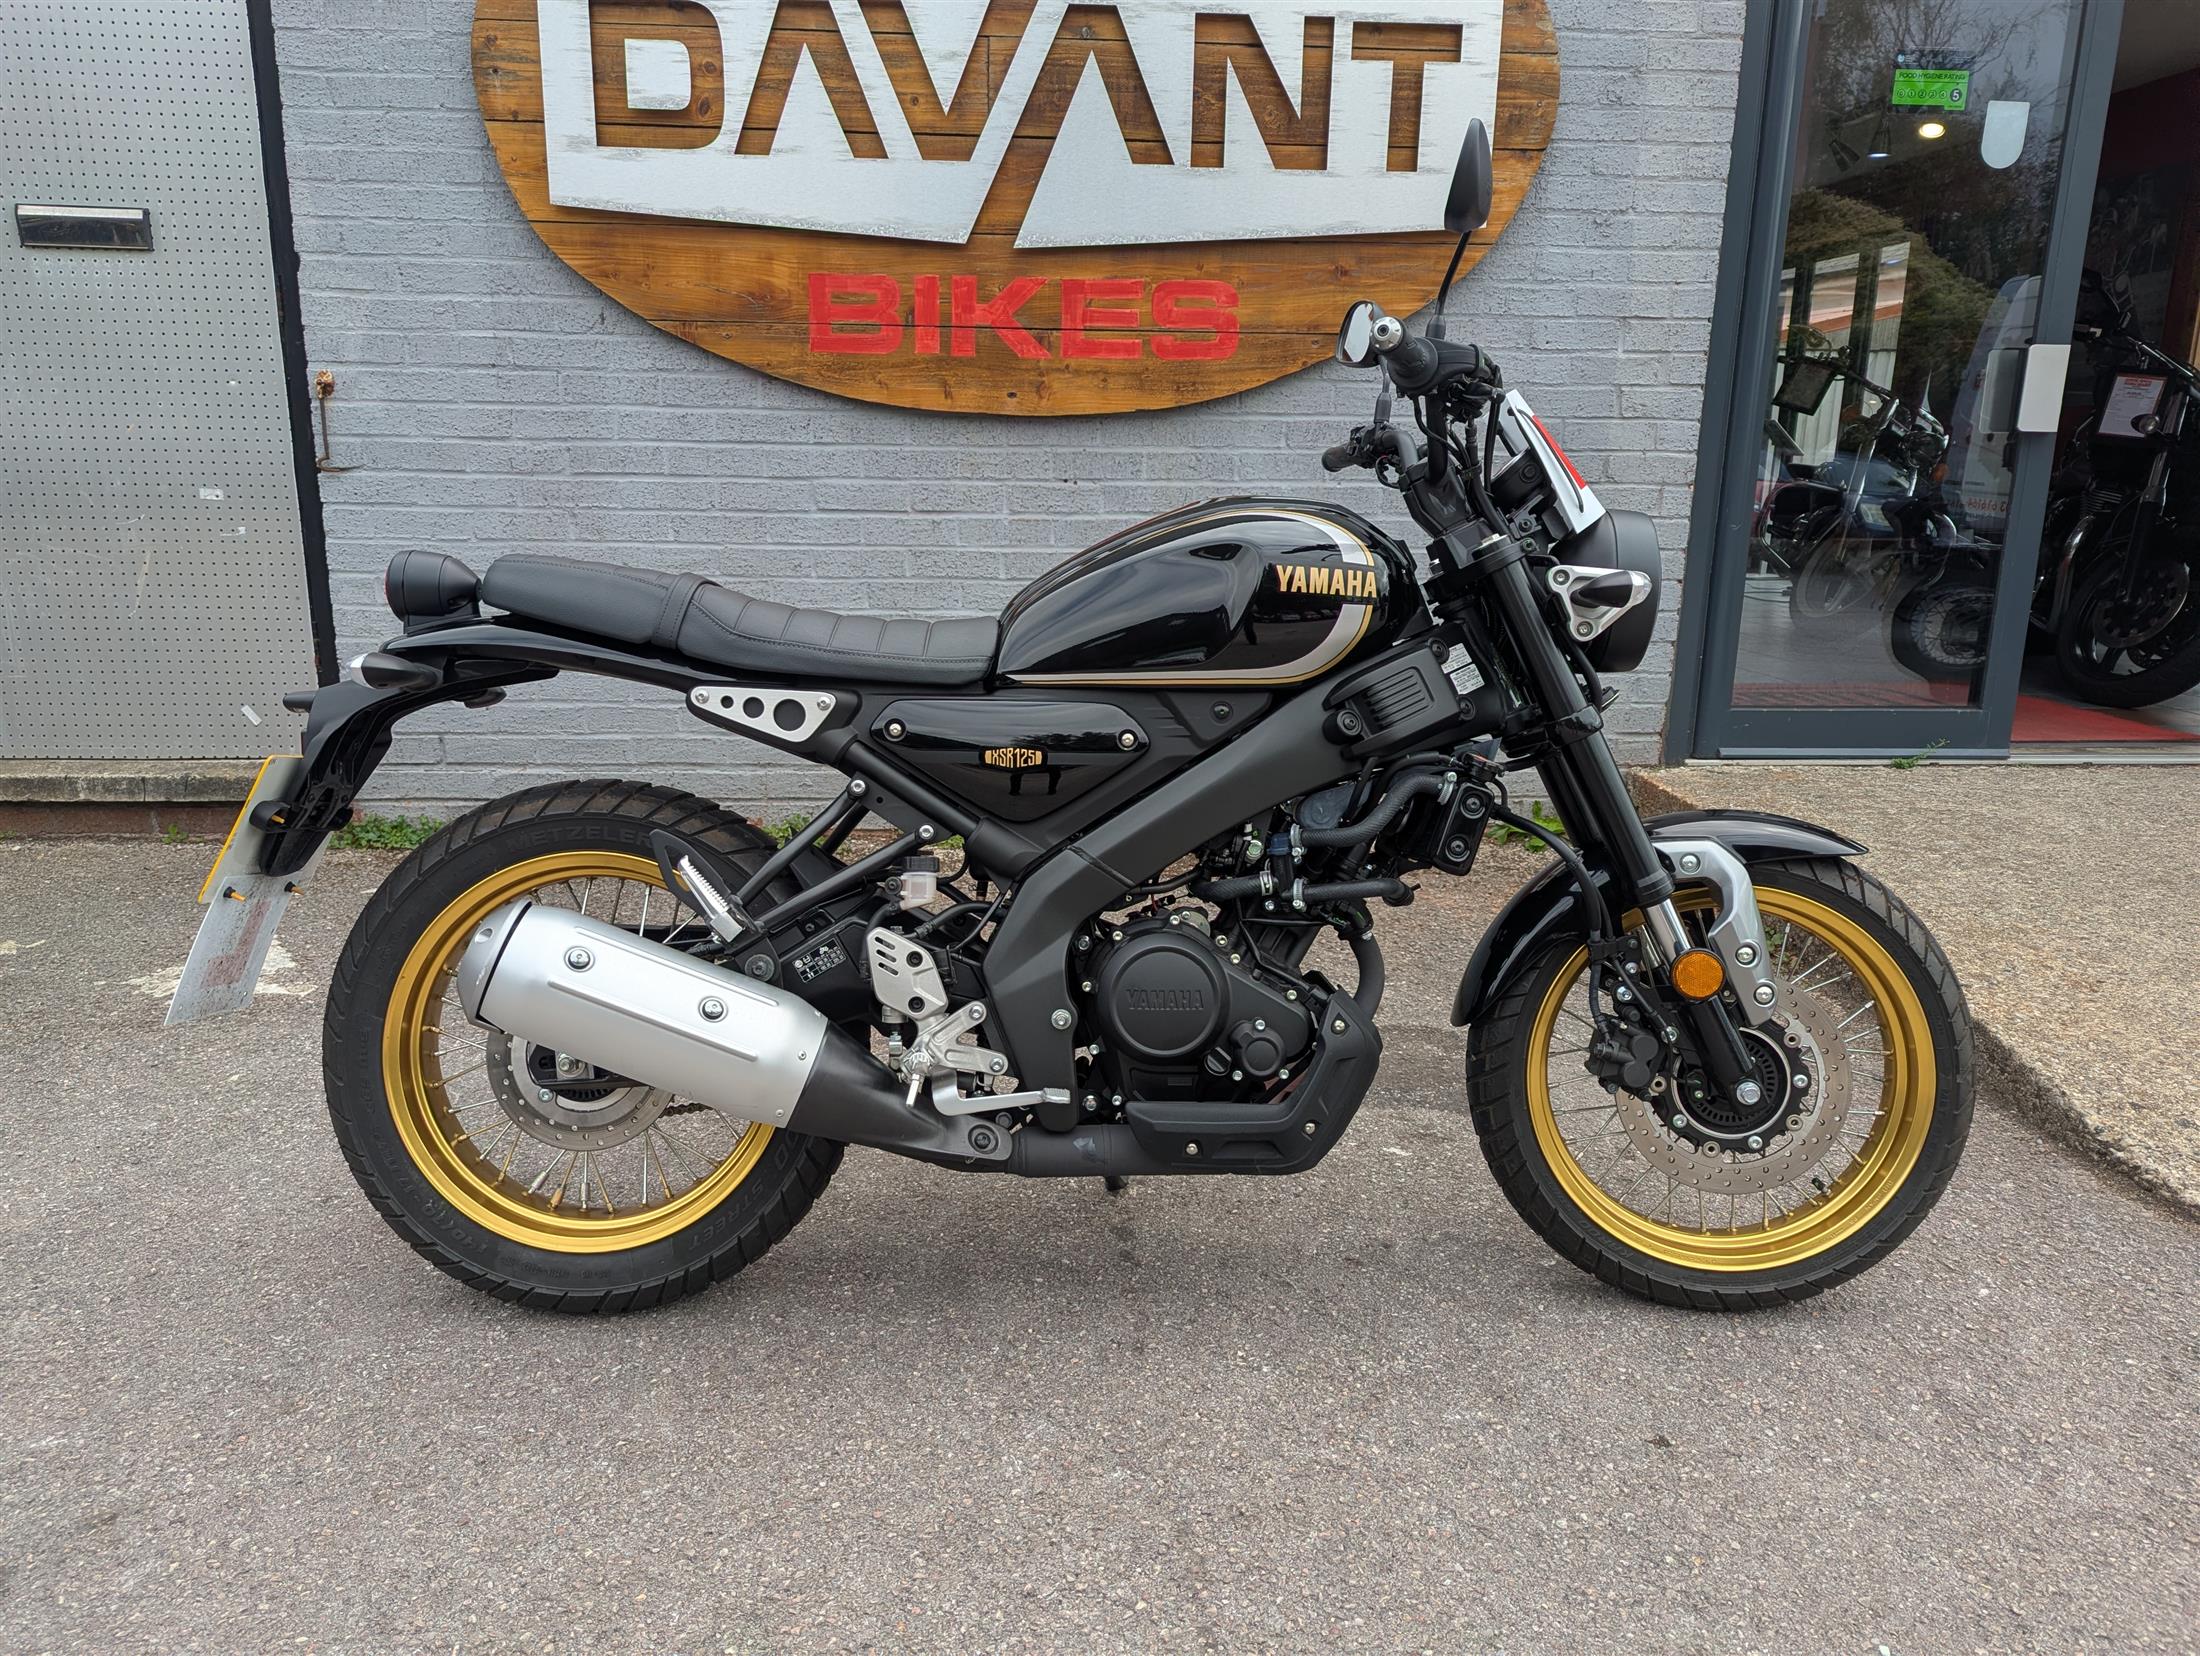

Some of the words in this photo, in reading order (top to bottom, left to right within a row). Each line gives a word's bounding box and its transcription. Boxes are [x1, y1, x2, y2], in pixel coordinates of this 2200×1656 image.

[588, 0, 1463, 172] DAVANT
[1952, 89, 1960, 101] 5
[807, 272, 1240, 362] BIKES
[1275, 564, 1378, 599] YAMAHA
[992, 747, 1035, 768] XSR125
[1126, 989, 1204, 1011] YAMAHA
